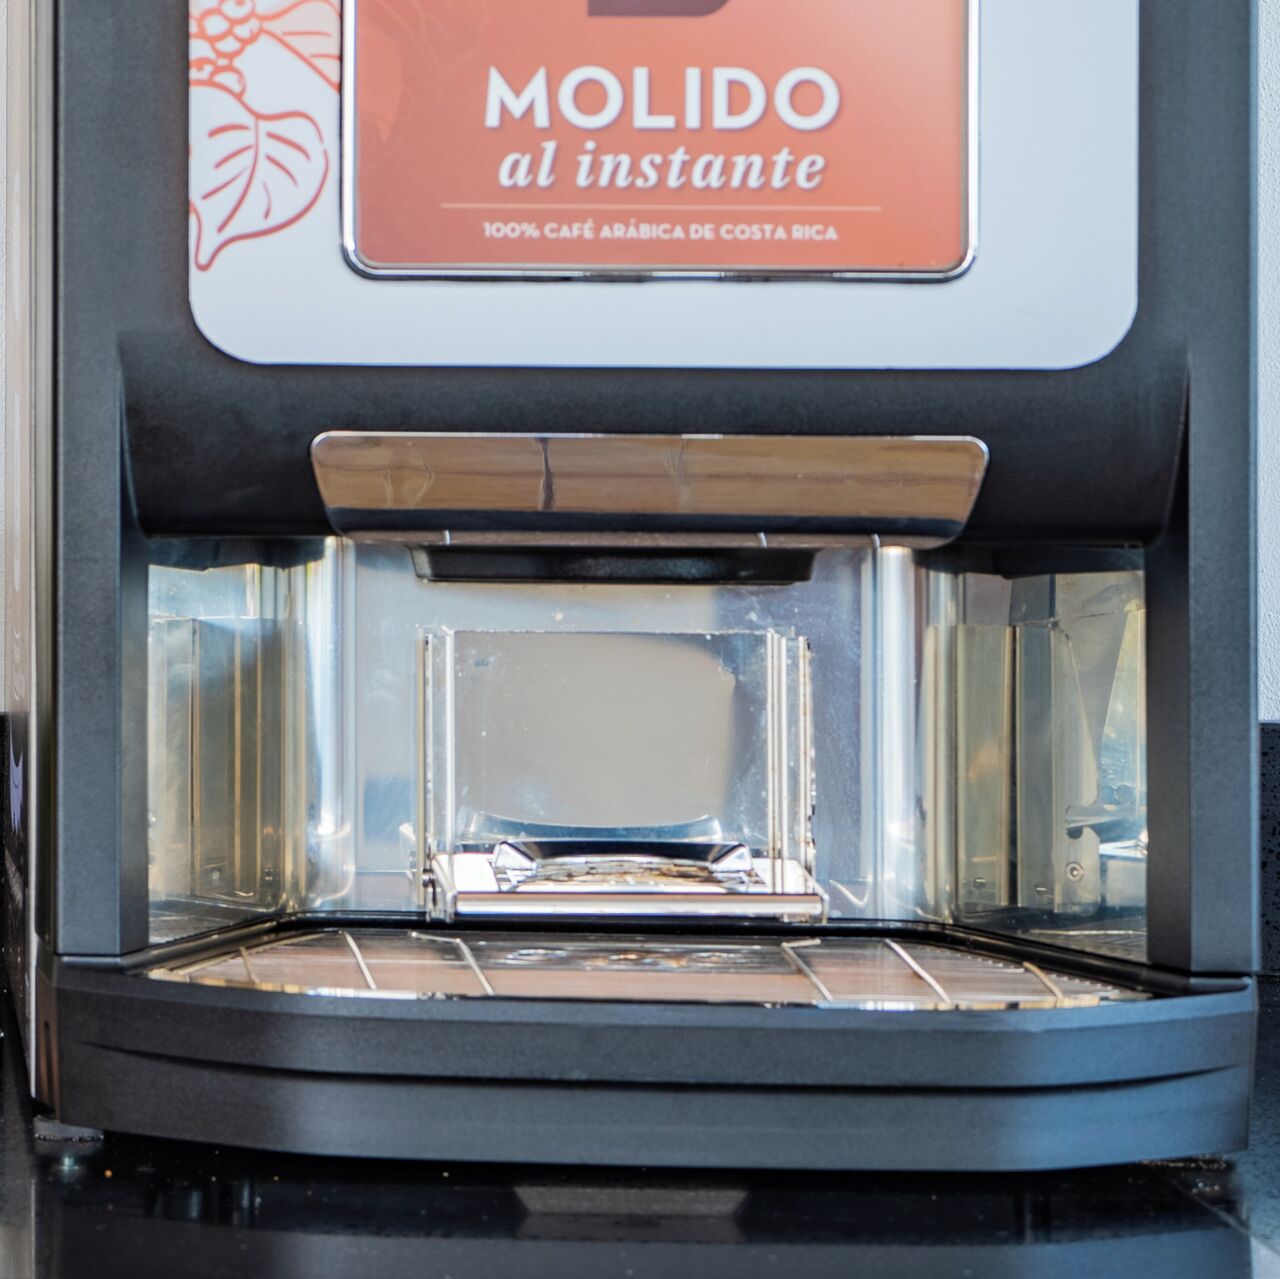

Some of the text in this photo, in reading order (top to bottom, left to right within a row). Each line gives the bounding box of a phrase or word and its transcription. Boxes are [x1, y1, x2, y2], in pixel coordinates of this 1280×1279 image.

[484, 65, 841, 131] MOLIDO
[498, 140, 826, 189] al instante
[484, 218, 838, 241] 100% CAFÉ ARÁBICA DE COSTA RICA
